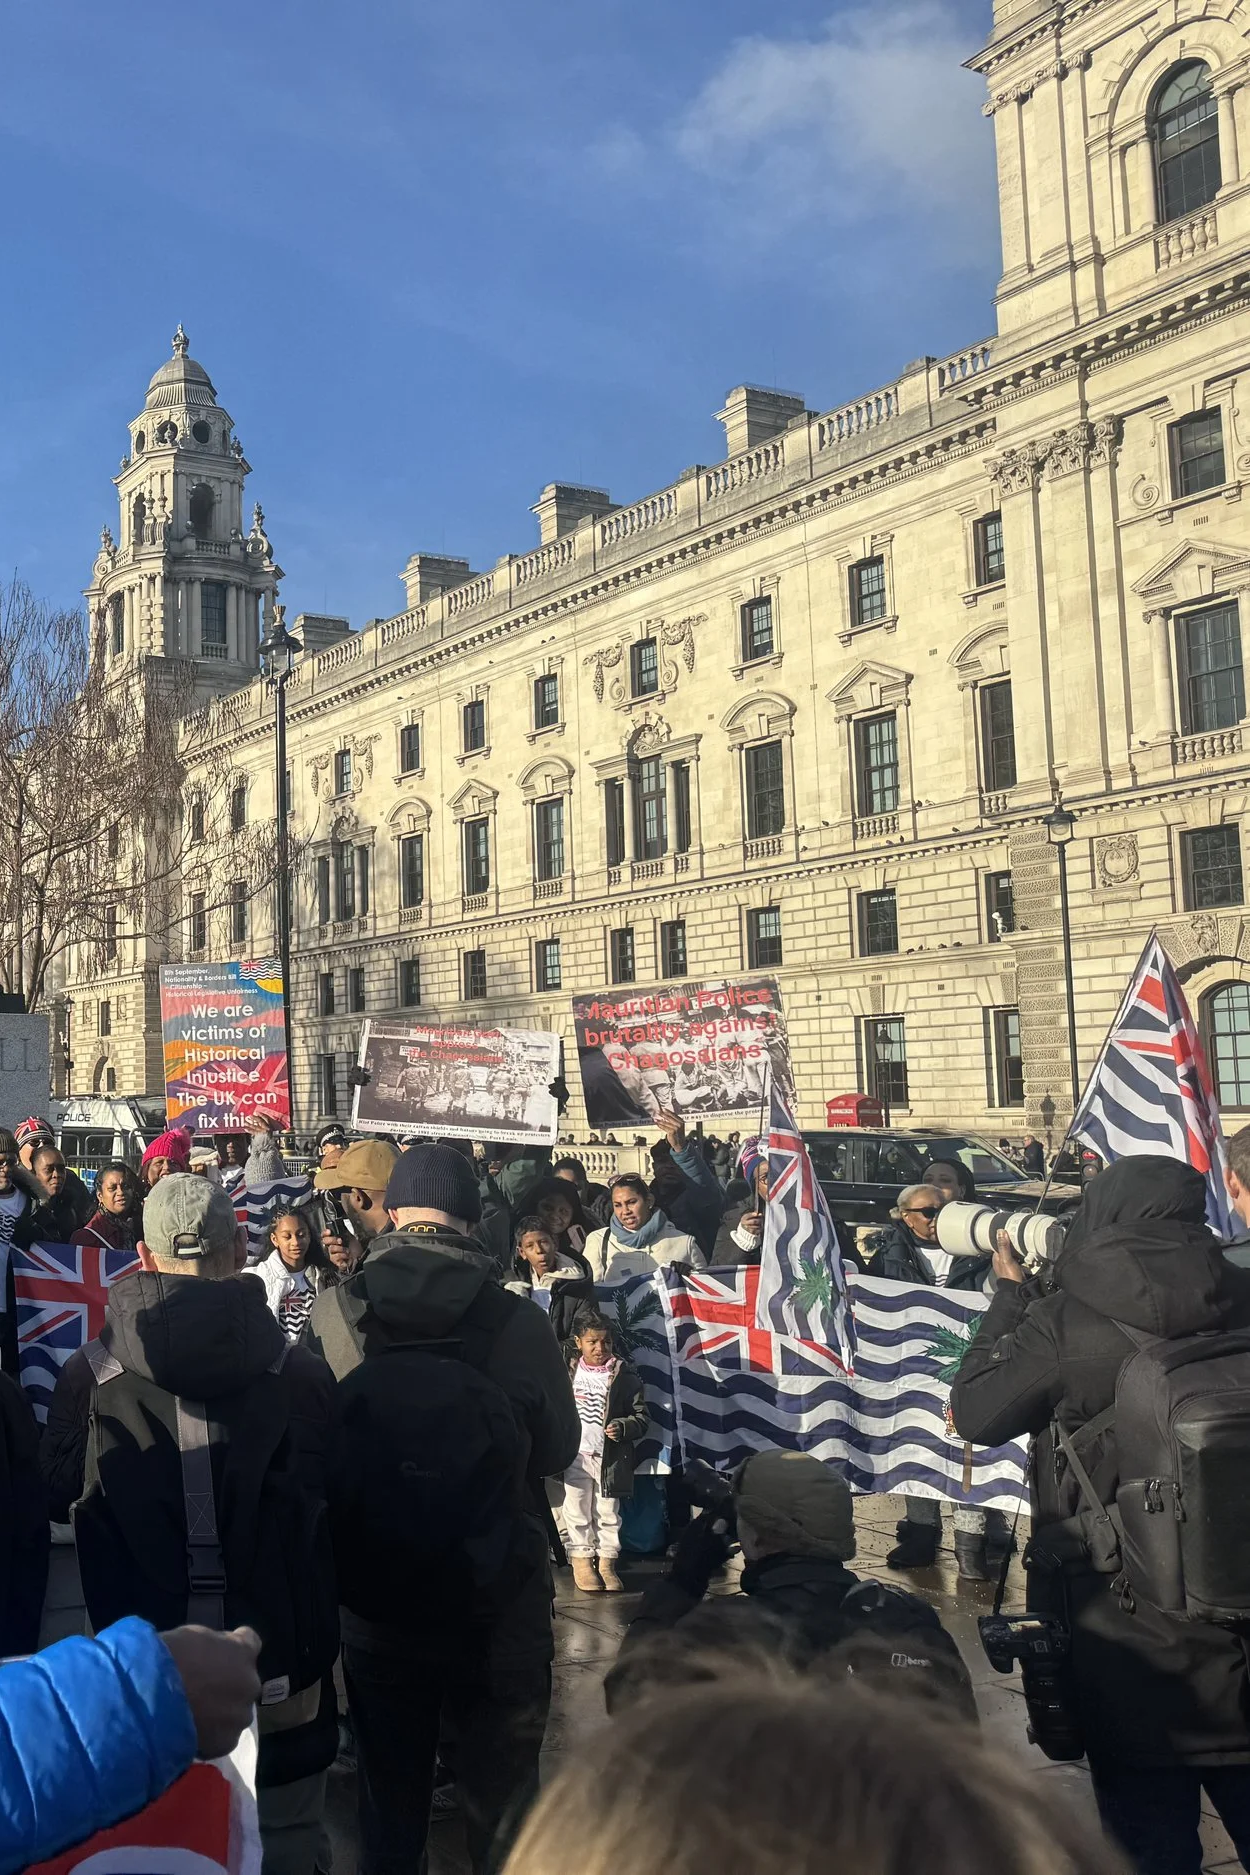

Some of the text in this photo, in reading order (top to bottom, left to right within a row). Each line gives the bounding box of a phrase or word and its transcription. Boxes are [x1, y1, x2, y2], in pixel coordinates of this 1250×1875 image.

[191, 1004, 254, 1018] We are
[582, 986, 771, 1020] Mauritian Police
[181, 1023, 267, 1040] victims of
[585, 1013, 777, 1046] brutality against
[184, 1045, 265, 1062] Historical
[609, 1043, 762, 1070] Chagossians
[186, 1068, 265, 1088] Injustice.
[176, 1090, 277, 1107] The UK can
[56, 1113, 91, 1122] POLICE
[198, 1113, 219, 1128] fix
